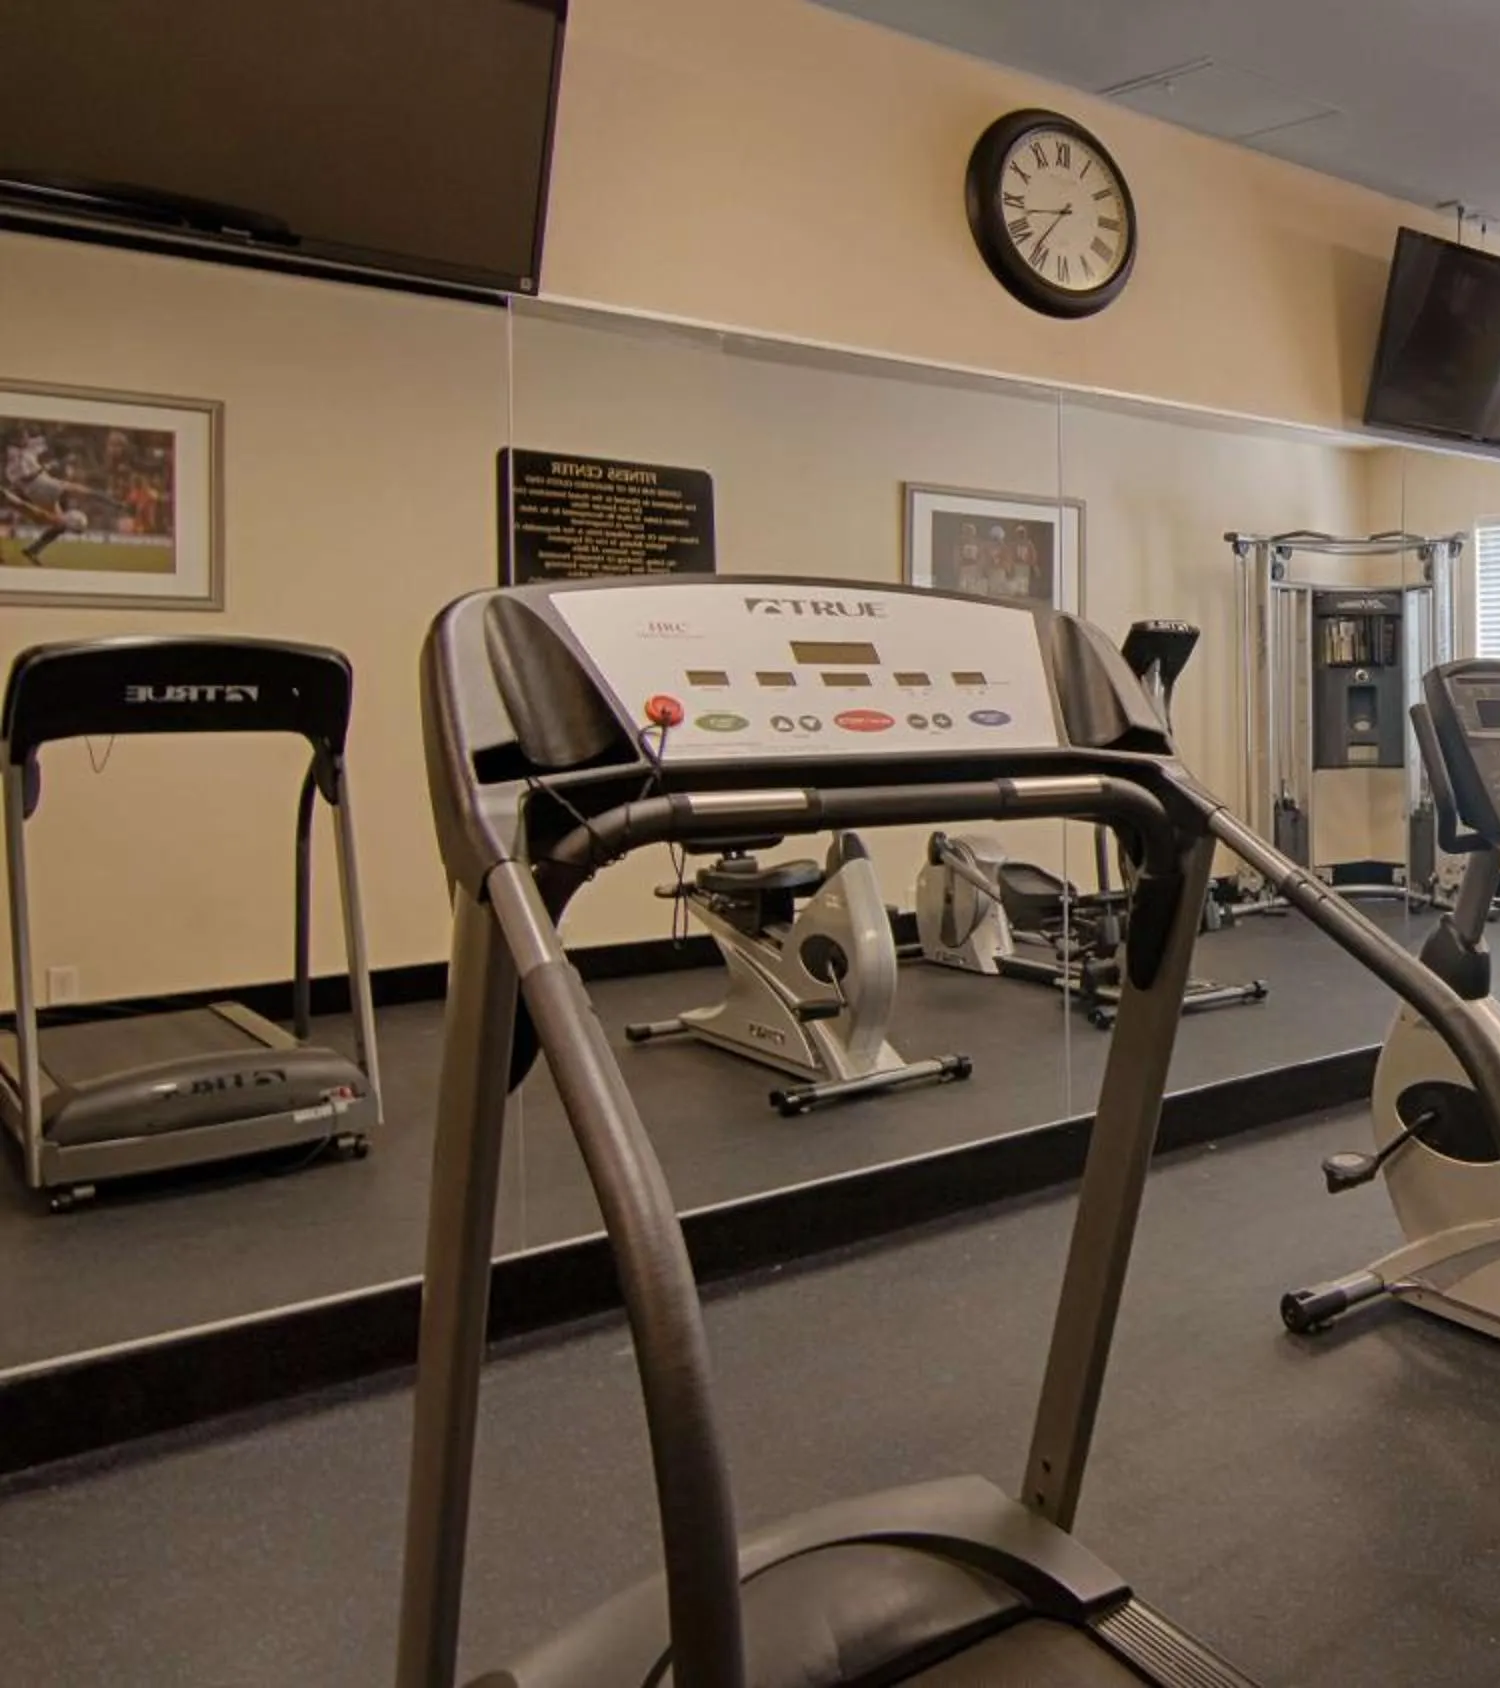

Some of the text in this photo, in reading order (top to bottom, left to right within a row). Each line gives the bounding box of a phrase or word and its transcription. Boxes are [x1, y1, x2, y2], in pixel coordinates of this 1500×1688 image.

[1055, 142, 1071, 169] XII
[1009, 160, 1031, 185] X
[781, 598, 889, 618] TRUE
